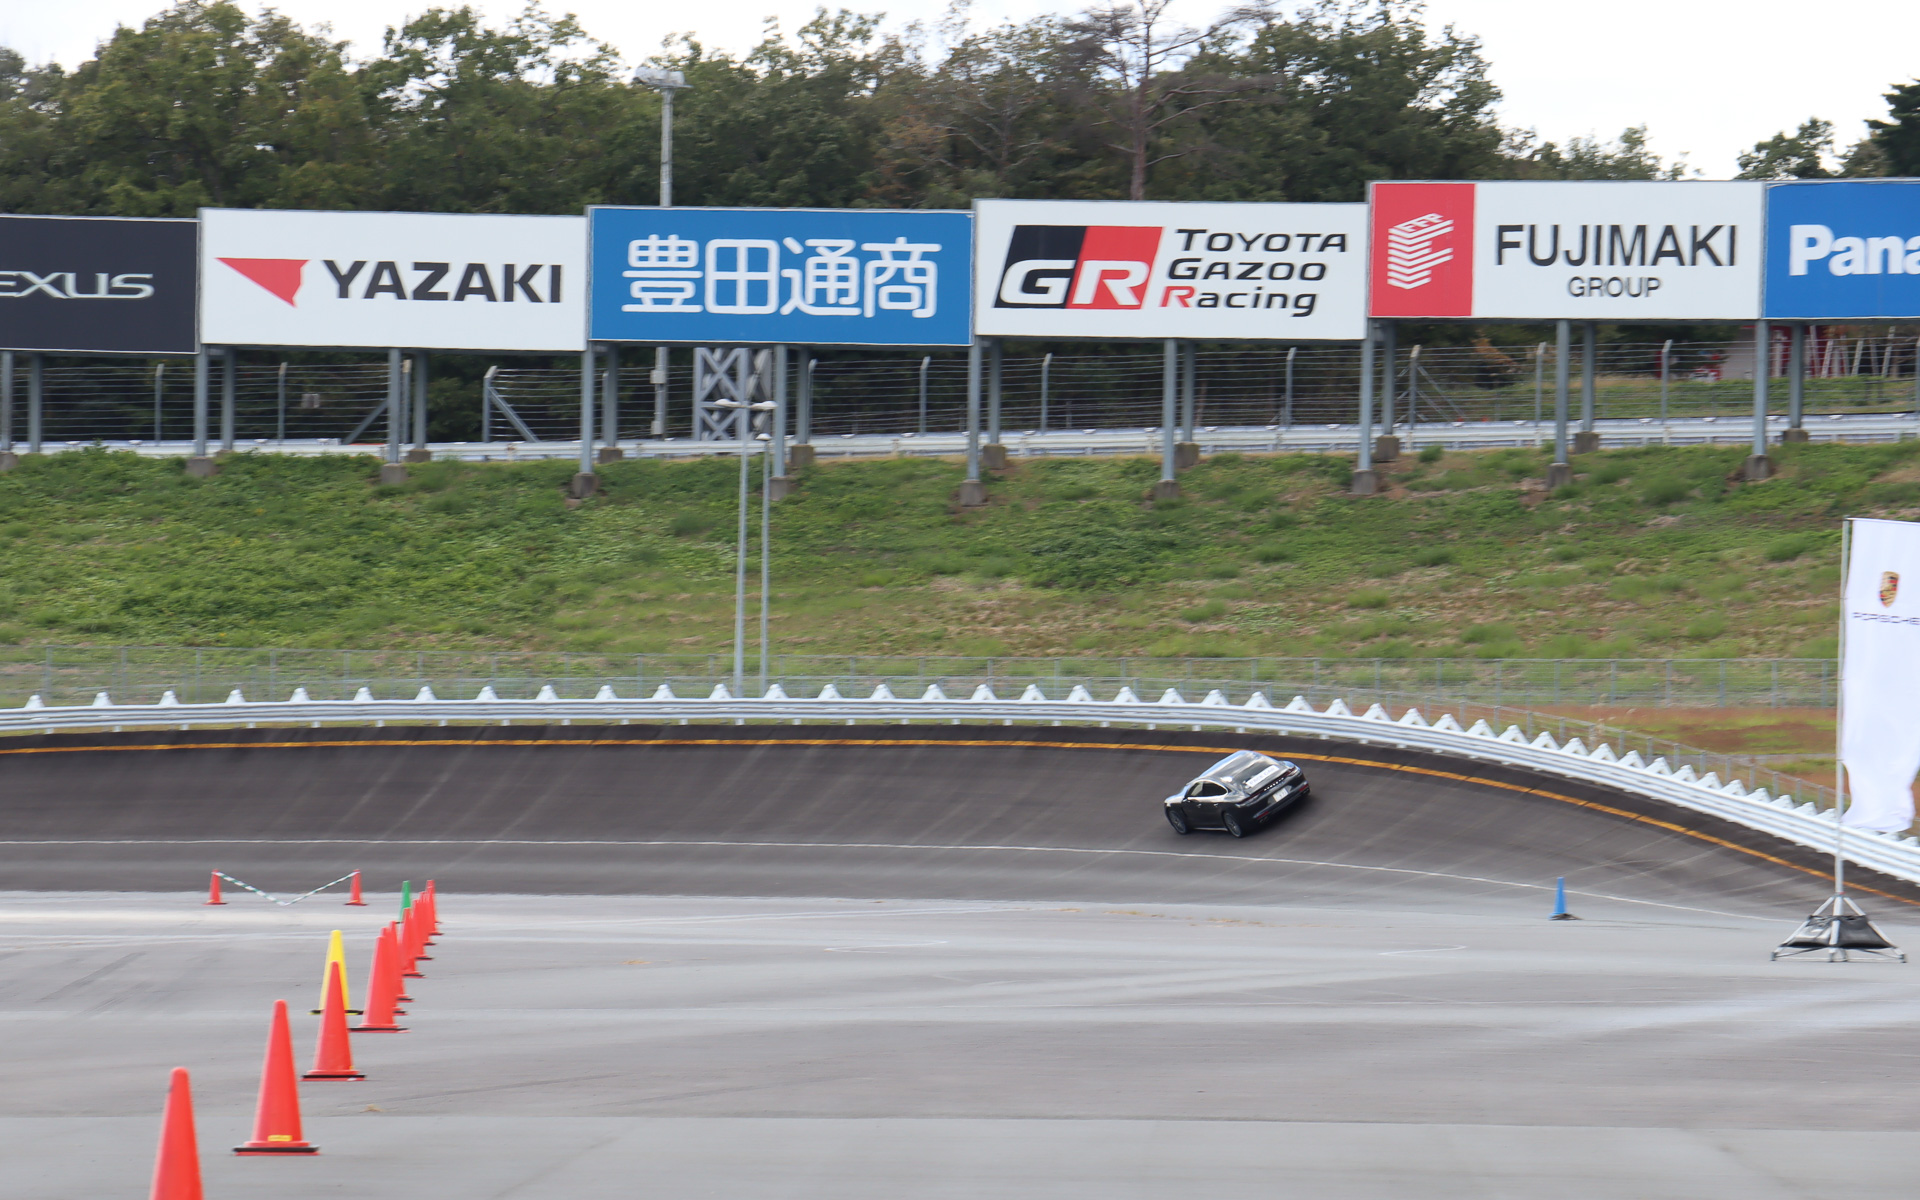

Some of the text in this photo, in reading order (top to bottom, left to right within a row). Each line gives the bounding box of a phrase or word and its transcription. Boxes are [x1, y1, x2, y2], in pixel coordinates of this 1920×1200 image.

[1176, 229, 1347, 252] TOYOTA
[1498, 224, 1737, 267] FUJIMAKI
[323, 259, 563, 304] YAZAKI
[622, 234, 942, 318] 豊田通商
[1000, 259, 1151, 306] GR
[1168, 258, 1327, 281] GAZOO
[1568, 276, 1661, 297] GROUP
[1160, 286, 1317, 317] Racing
